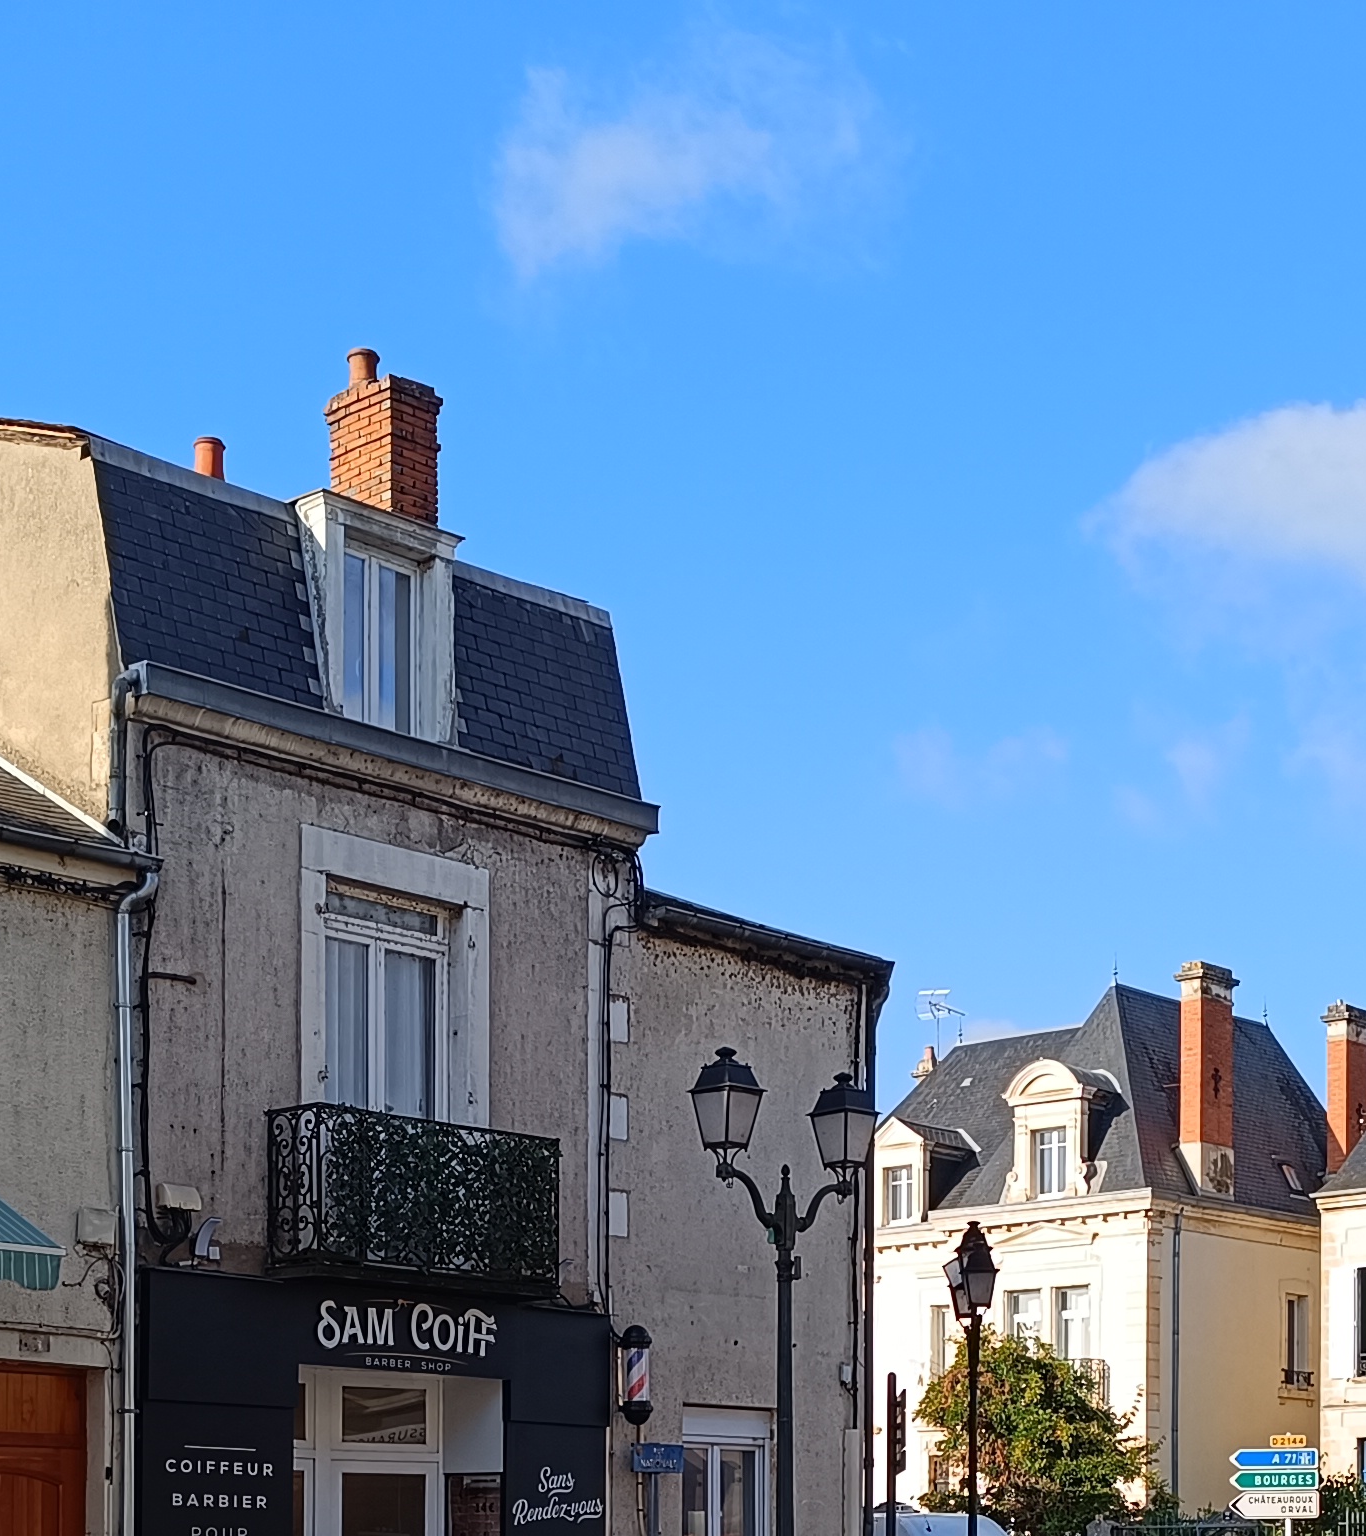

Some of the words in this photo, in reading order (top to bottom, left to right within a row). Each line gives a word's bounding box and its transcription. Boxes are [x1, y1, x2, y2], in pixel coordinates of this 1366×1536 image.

[365, 1357, 411, 1369] BARBER
[421, 1361, 452, 1372] SHOP
[1271, 1453, 1280, 1464] A
[1284, 1453, 1297, 1464] 71
[165, 1459, 274, 1477] COIFFEUR
[538, 1466, 576, 1498] Sans
[1254, 1475, 1313, 1486] BOURGES
[172, 1493, 267, 1509] BARBIER
[1248, 1494, 1314, 1504] CHÂTEAUROUX
[512, 1496, 604, 1526] Rendez-vous
